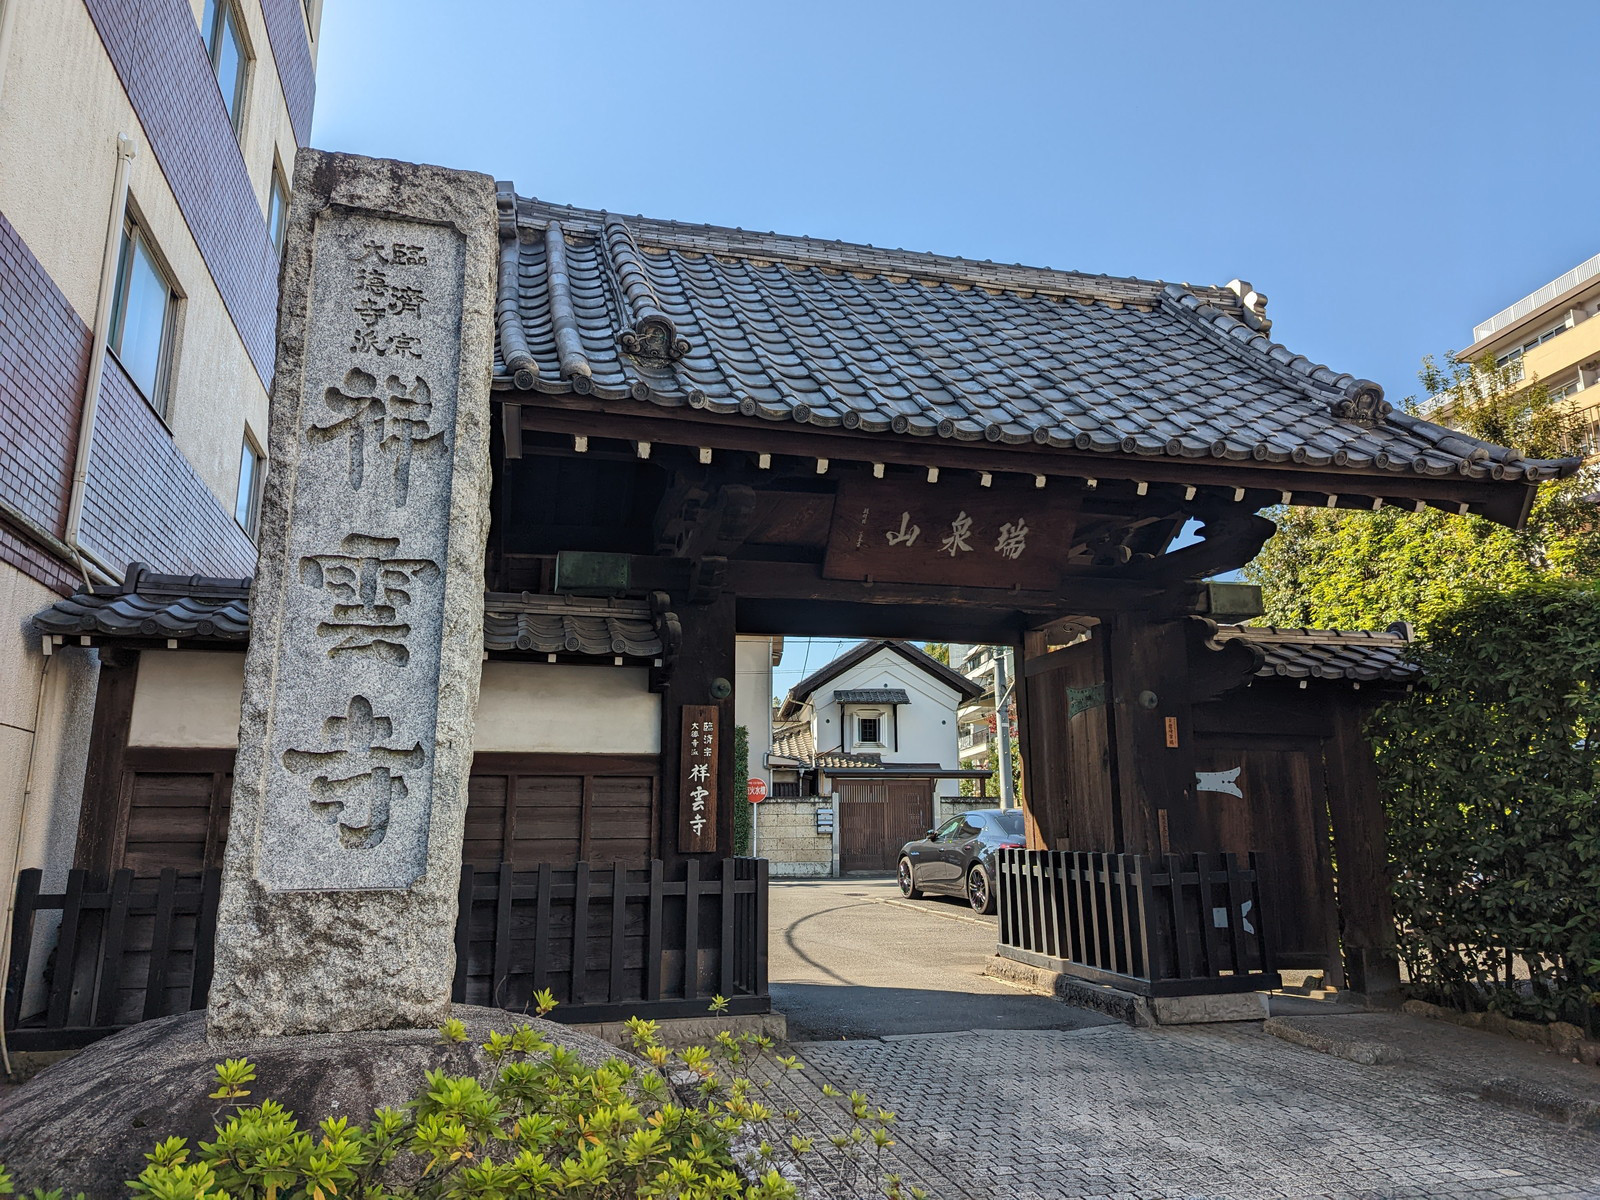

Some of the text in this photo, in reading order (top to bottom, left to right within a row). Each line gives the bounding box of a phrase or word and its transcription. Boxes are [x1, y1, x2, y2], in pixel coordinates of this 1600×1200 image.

[282, 366, 448, 849] 祥雲寺
[687, 763, 711, 836] 祥雲寺
